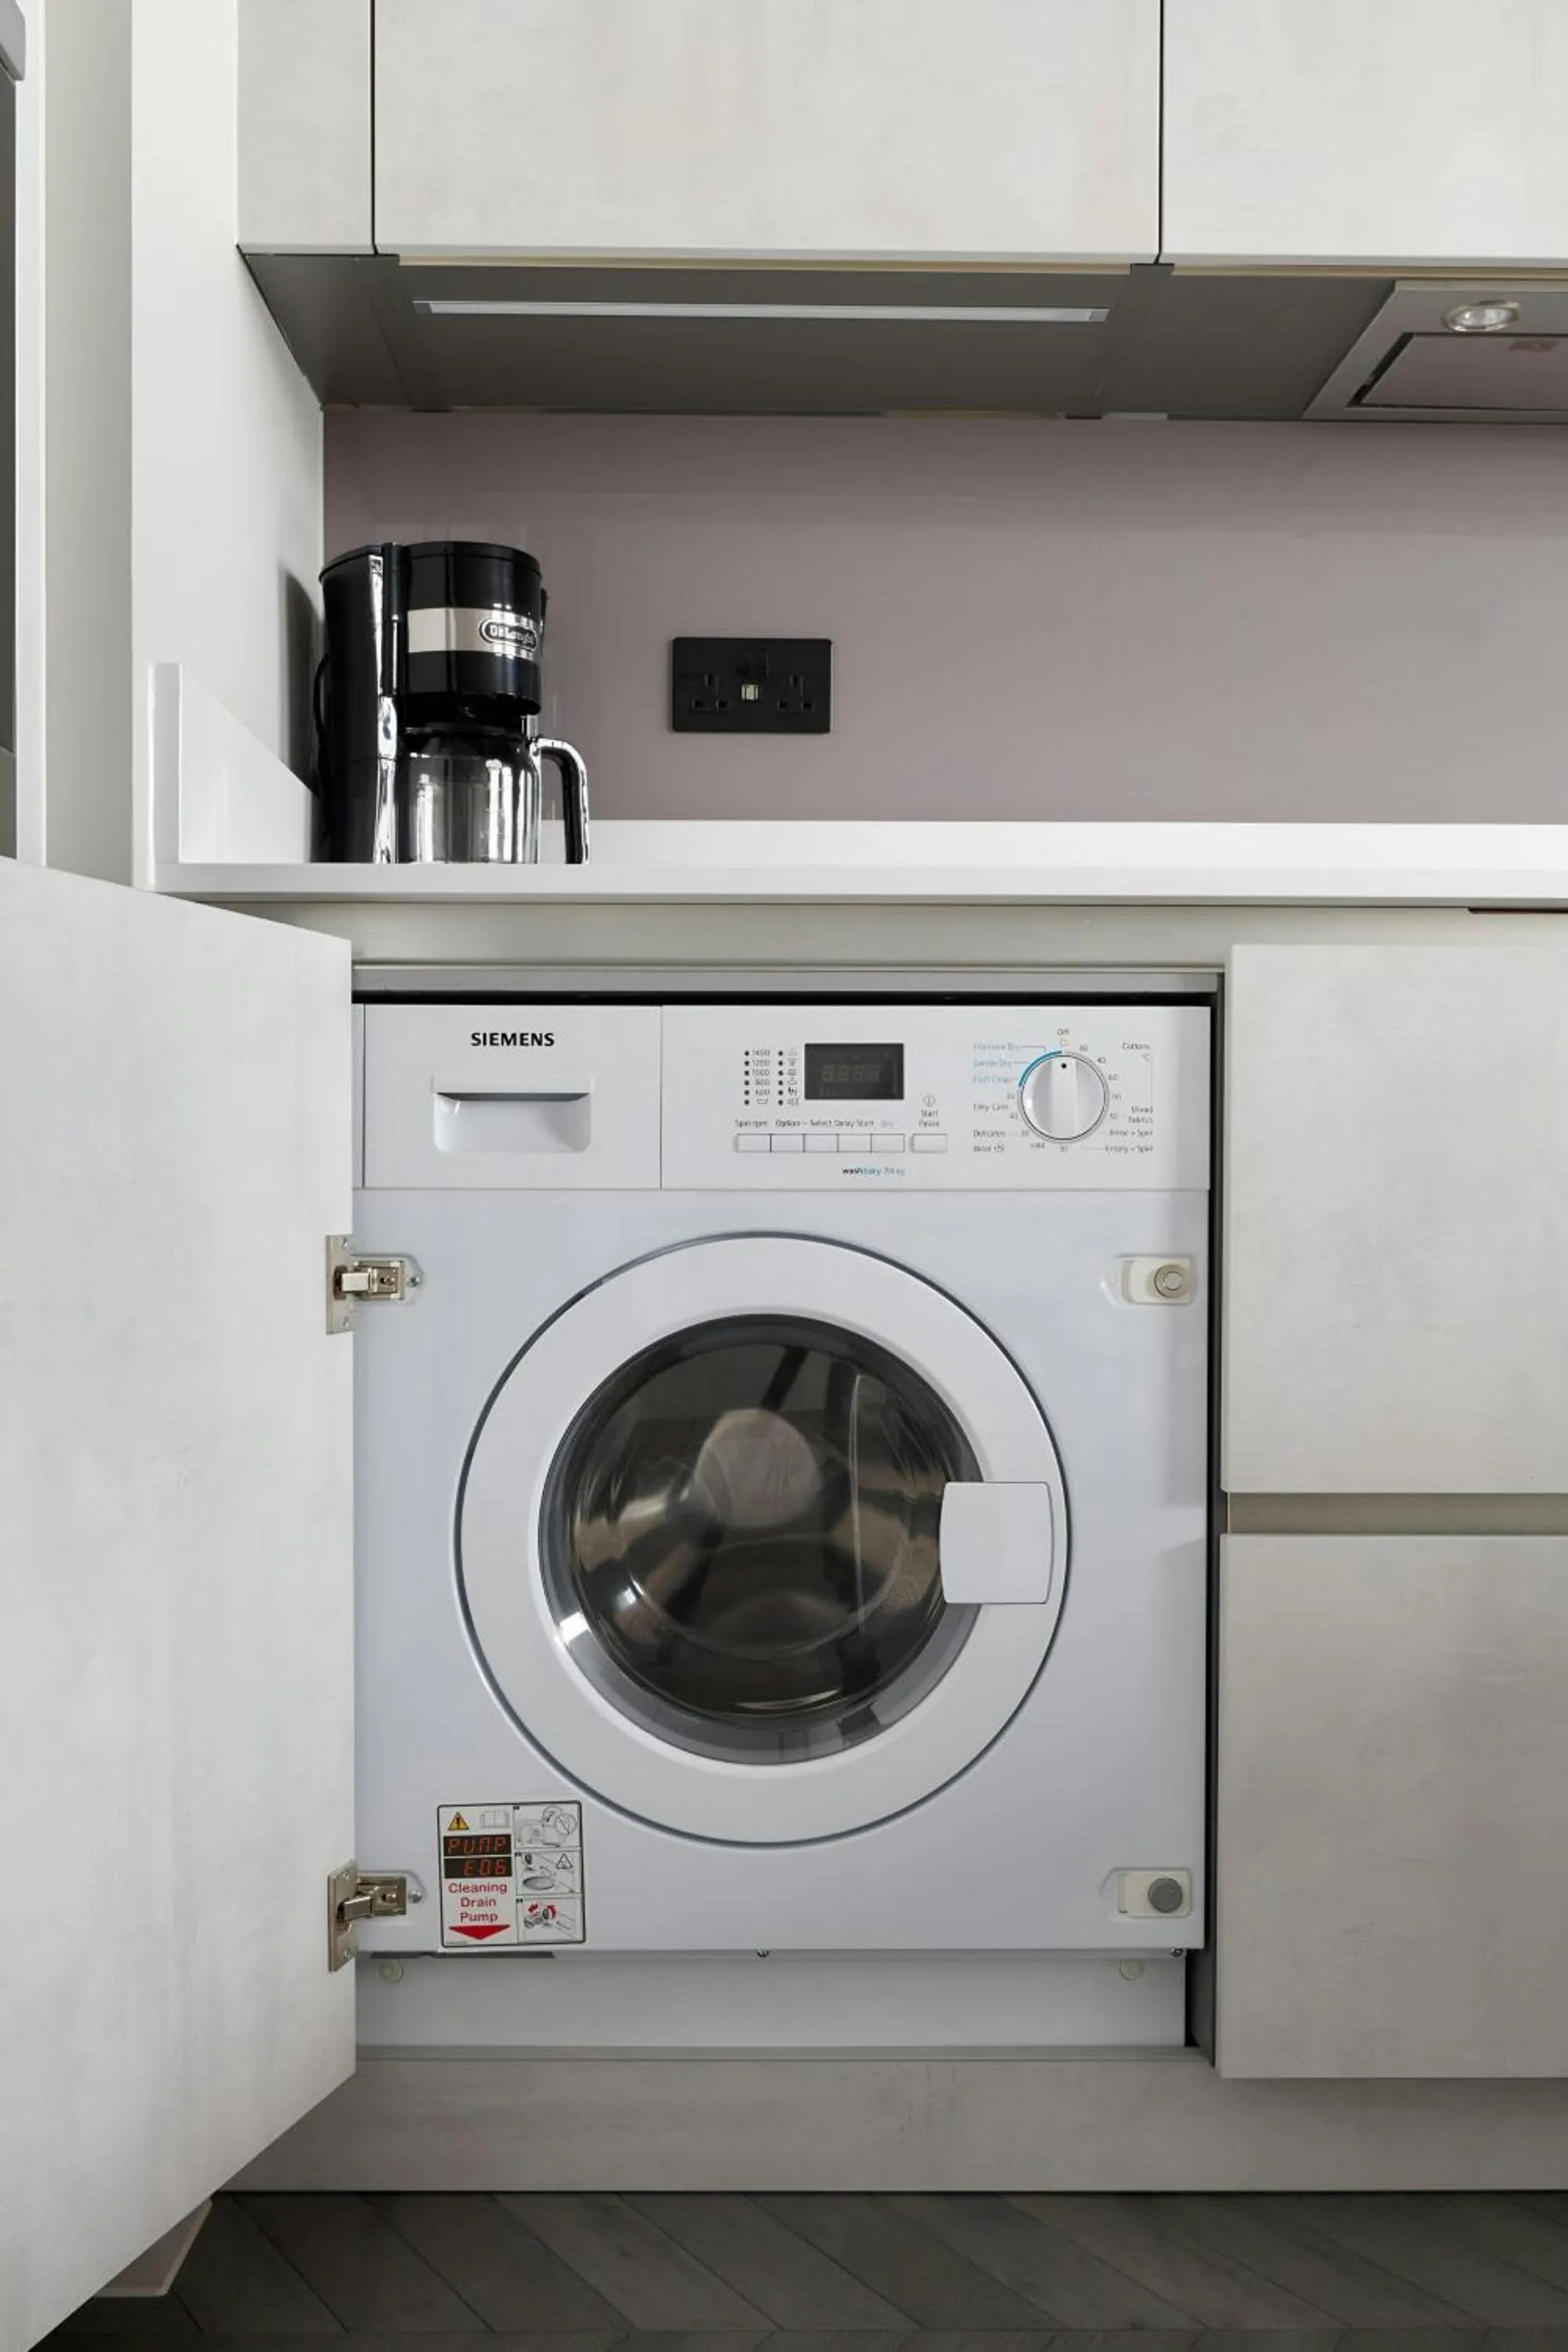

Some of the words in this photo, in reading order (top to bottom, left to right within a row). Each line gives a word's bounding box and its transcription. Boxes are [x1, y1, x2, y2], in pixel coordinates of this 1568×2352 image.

[470, 1033, 555, 1047] SIEMENS
[448, 1882, 508, 1894] Cleaning
[460, 1897, 496, 1907] Drain
[460, 1912, 499, 1923] Pump
